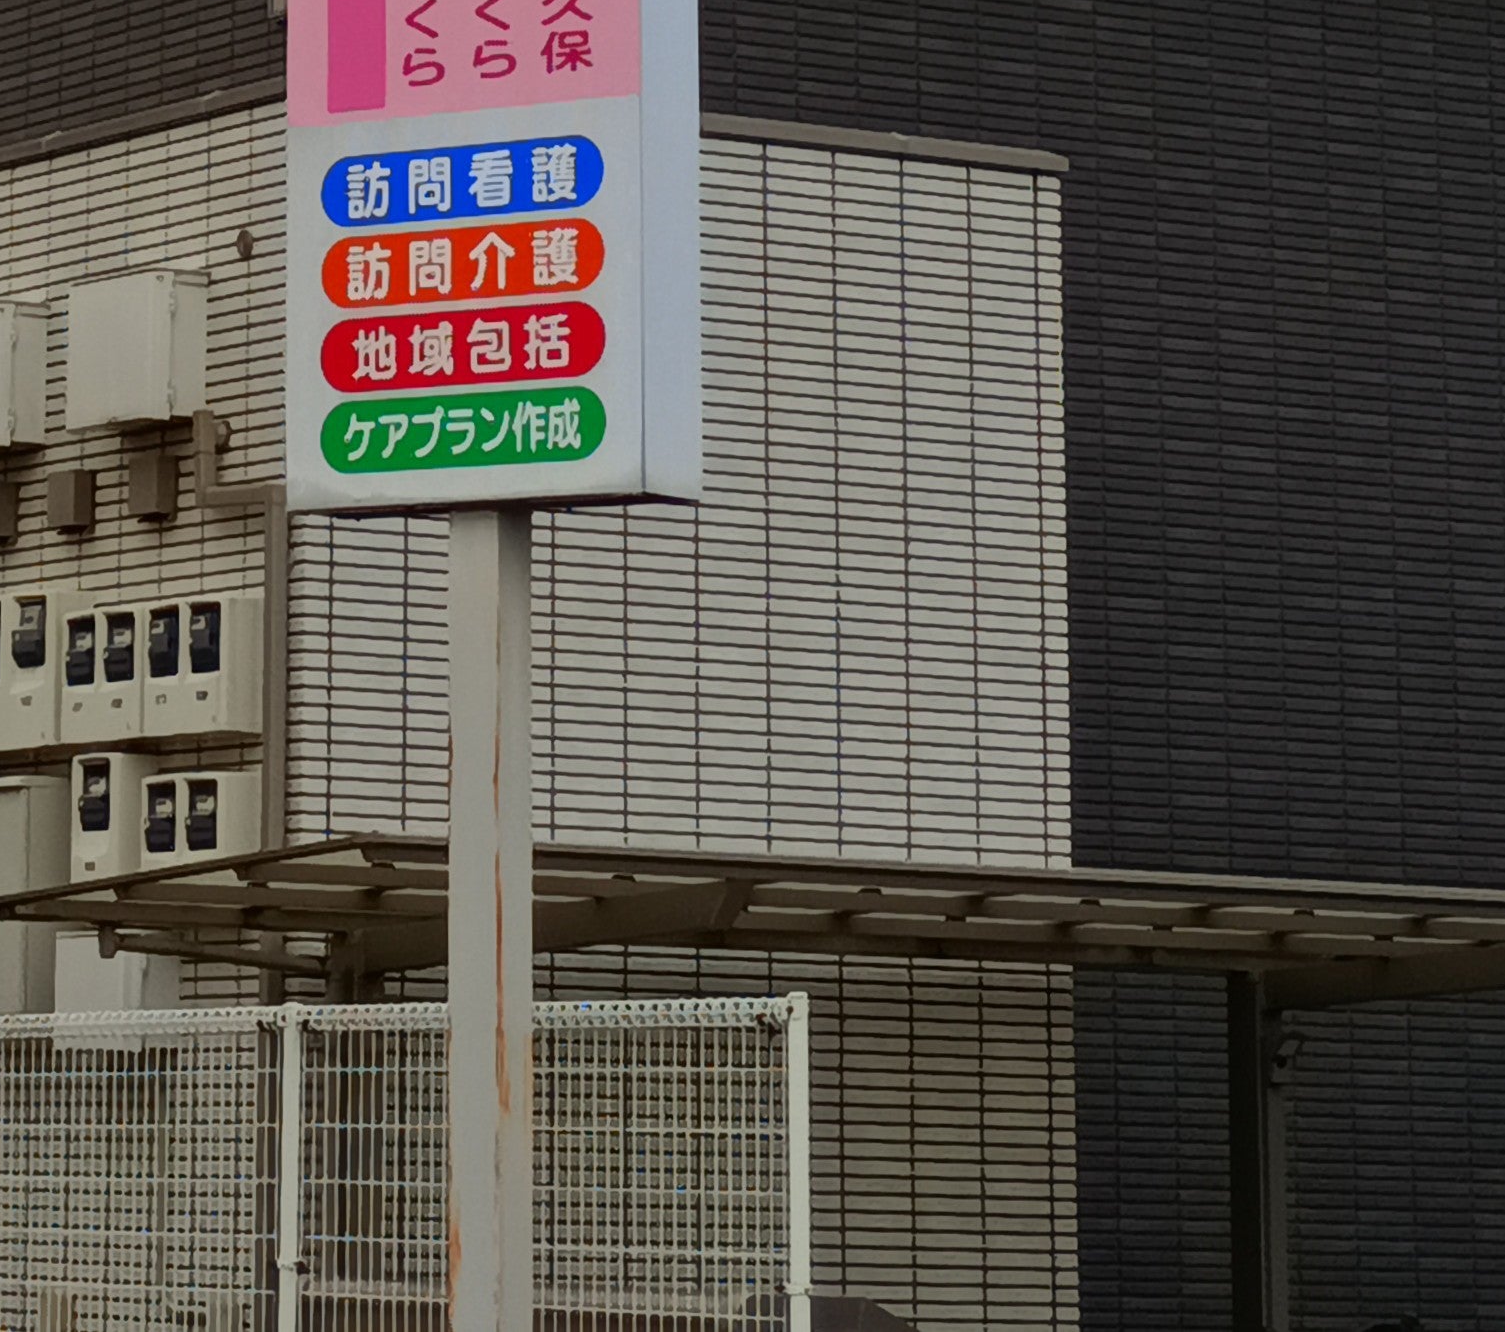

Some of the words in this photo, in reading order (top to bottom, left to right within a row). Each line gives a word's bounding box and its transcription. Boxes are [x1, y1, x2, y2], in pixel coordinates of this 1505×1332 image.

[346, 143, 578, 219] 訪問看護
[346, 227, 579, 301] 訪問介護
[352, 313, 572, 381] 地域包括
[344, 397, 581, 462] ケアプラン作成
